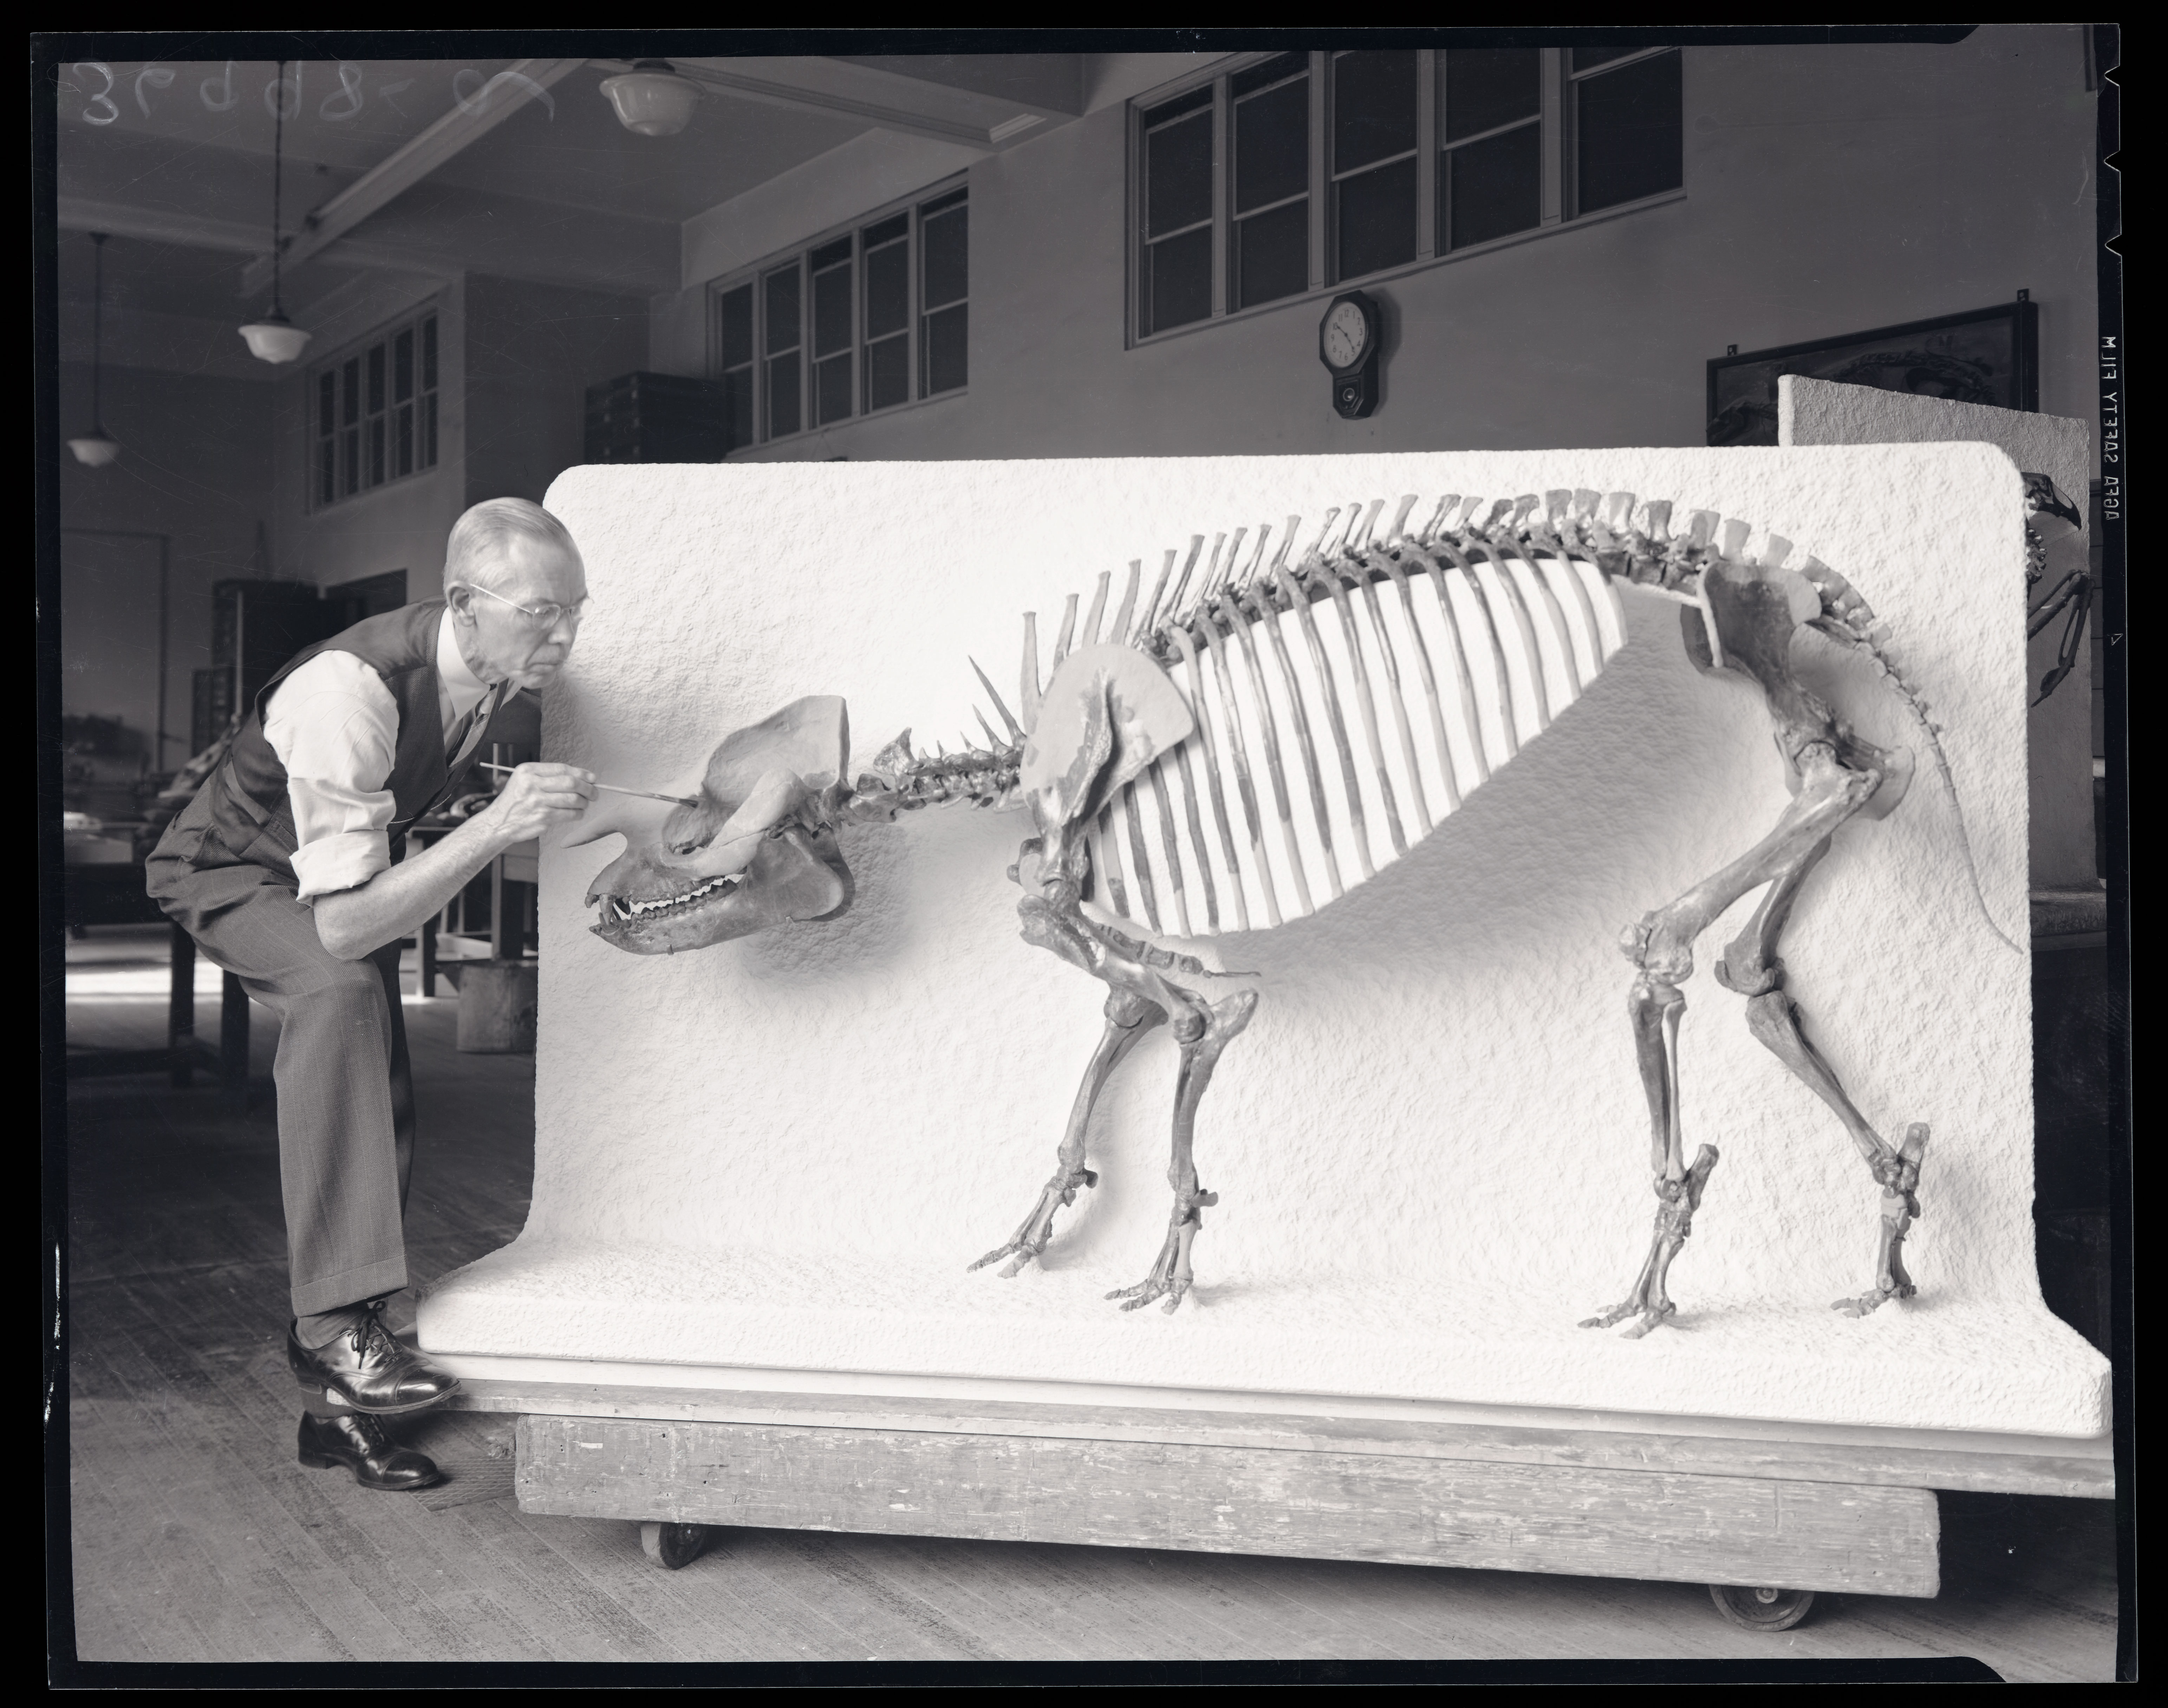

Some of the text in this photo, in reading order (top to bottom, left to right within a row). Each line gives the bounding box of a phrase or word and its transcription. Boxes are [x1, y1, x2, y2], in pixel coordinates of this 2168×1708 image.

[1345, 309, 1349, 318] 12
[1353, 311, 1355, 319] 1
[1339, 314, 1342, 322] 11
[1358, 317, 1360, 325] 2
[1359, 327, 1363, 336] 3
[1331, 334, 1335, 342] 9
[1339, 351, 1342, 359] 7
[1345, 352, 1348, 361] 6
